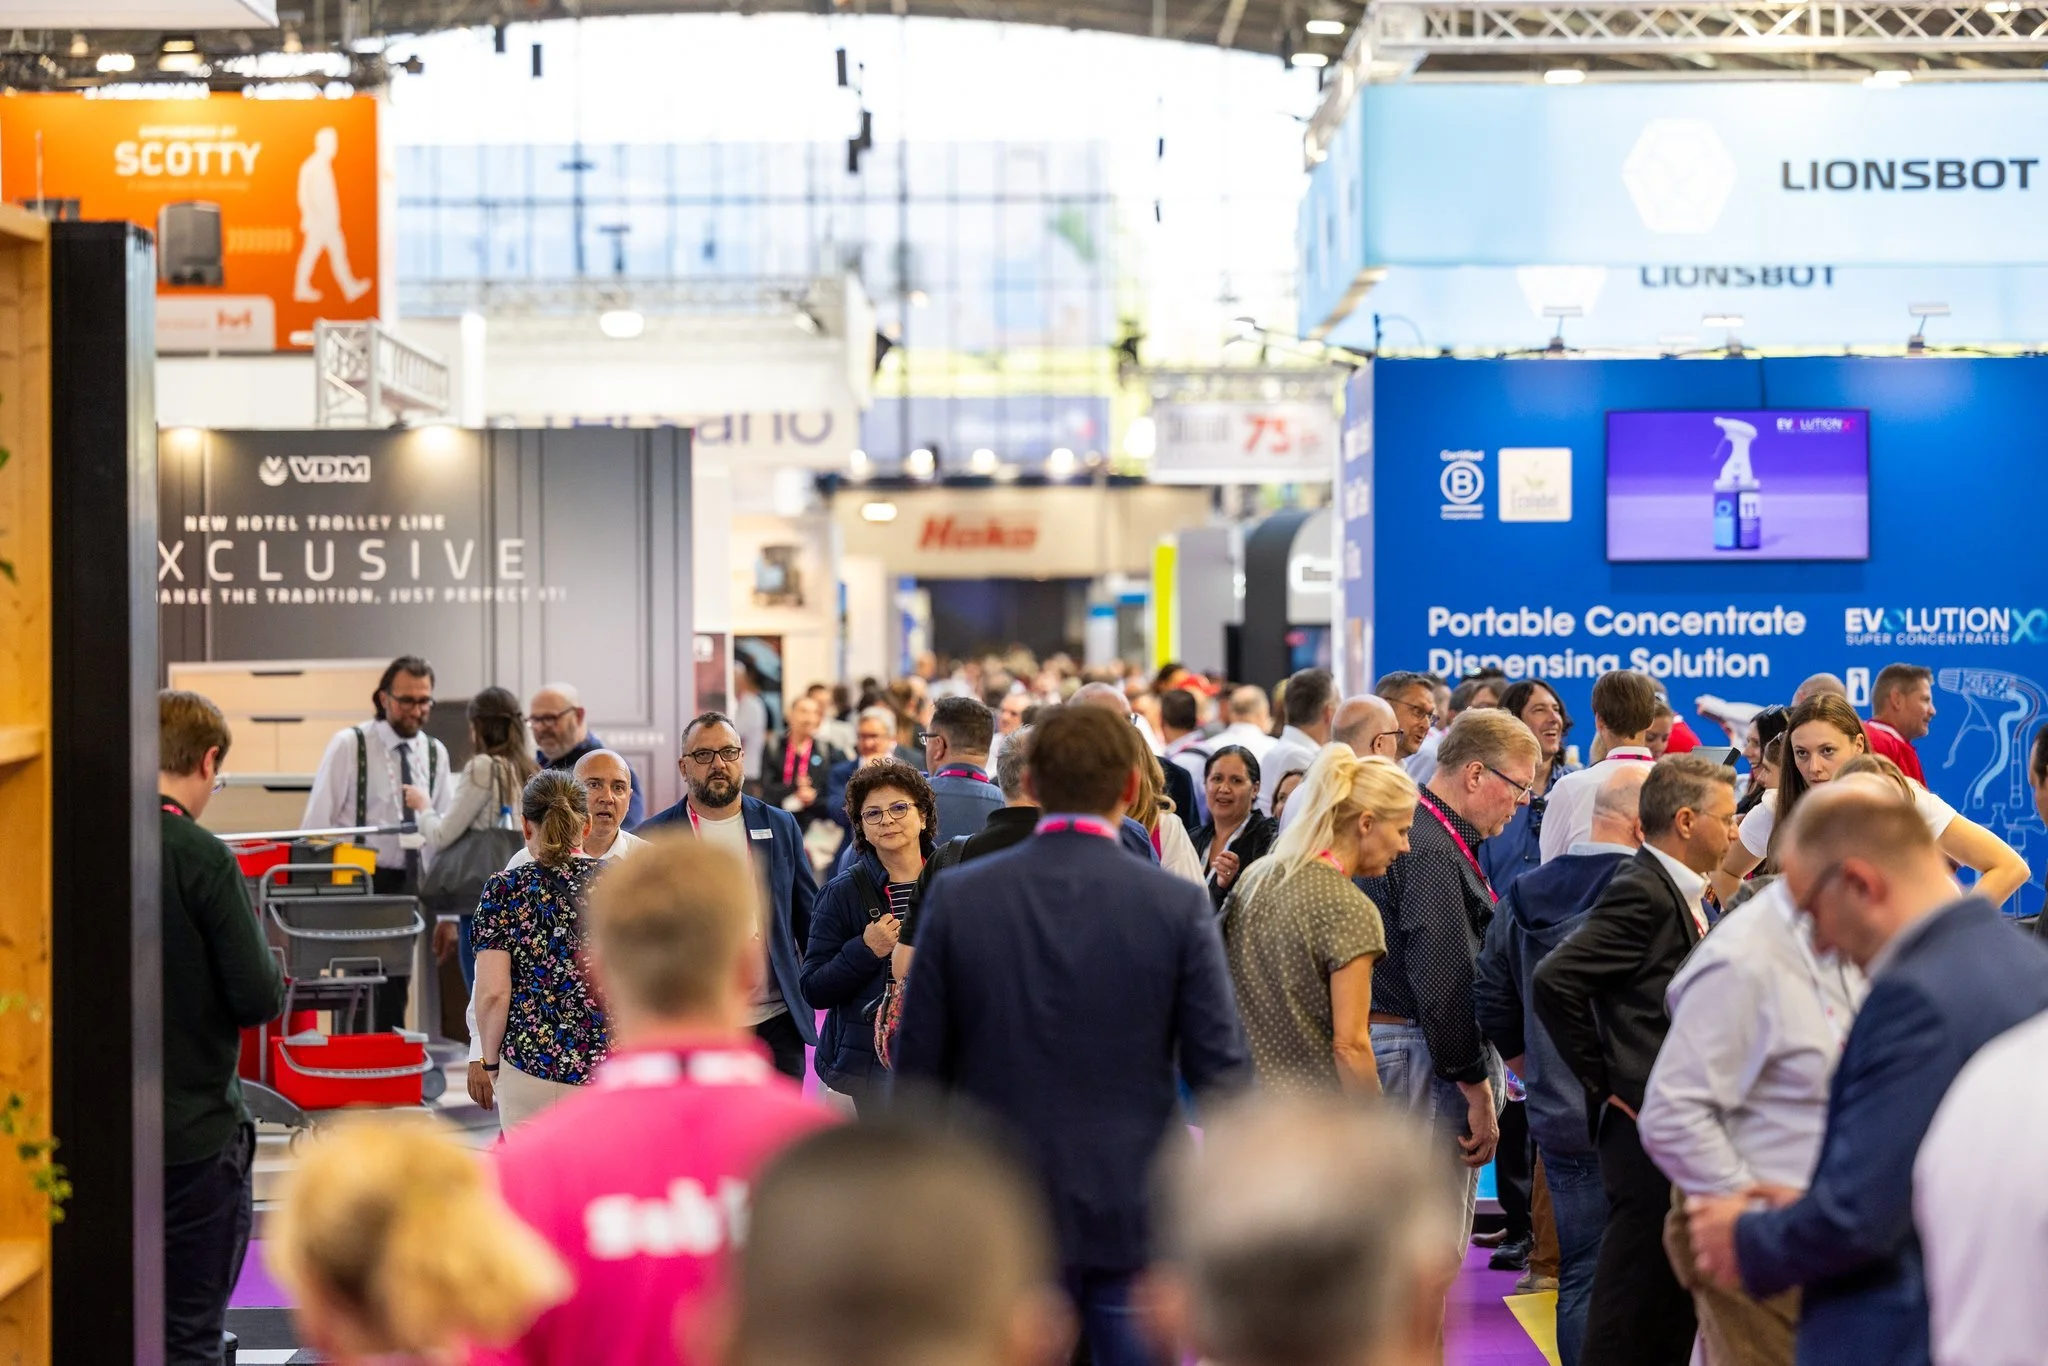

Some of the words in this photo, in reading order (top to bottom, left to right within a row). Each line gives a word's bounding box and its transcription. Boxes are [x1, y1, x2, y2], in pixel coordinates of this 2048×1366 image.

[115, 141, 262, 176] SCOTTY
[1783, 160, 2039, 190] LIONSBOT
[291, 458, 369, 480] VDM
[184, 515, 228, 532] NEW
[236, 515, 298, 532] HOTEL
[307, 515, 391, 532] TROLLEY
[400, 514, 446, 531] LINE
[156, 588, 212, 604] ANGE
[220, 588, 257, 604] THE
[390, 586, 435, 604] JUST
[1428, 605, 1576, 637] Portable
[1585, 604, 1806, 637] Concentrate
[1846, 632, 1891, 645] SUPER
[1896, 632, 2009, 645] CONCENTRATES
[1630, 647, 1770, 678] Solution
